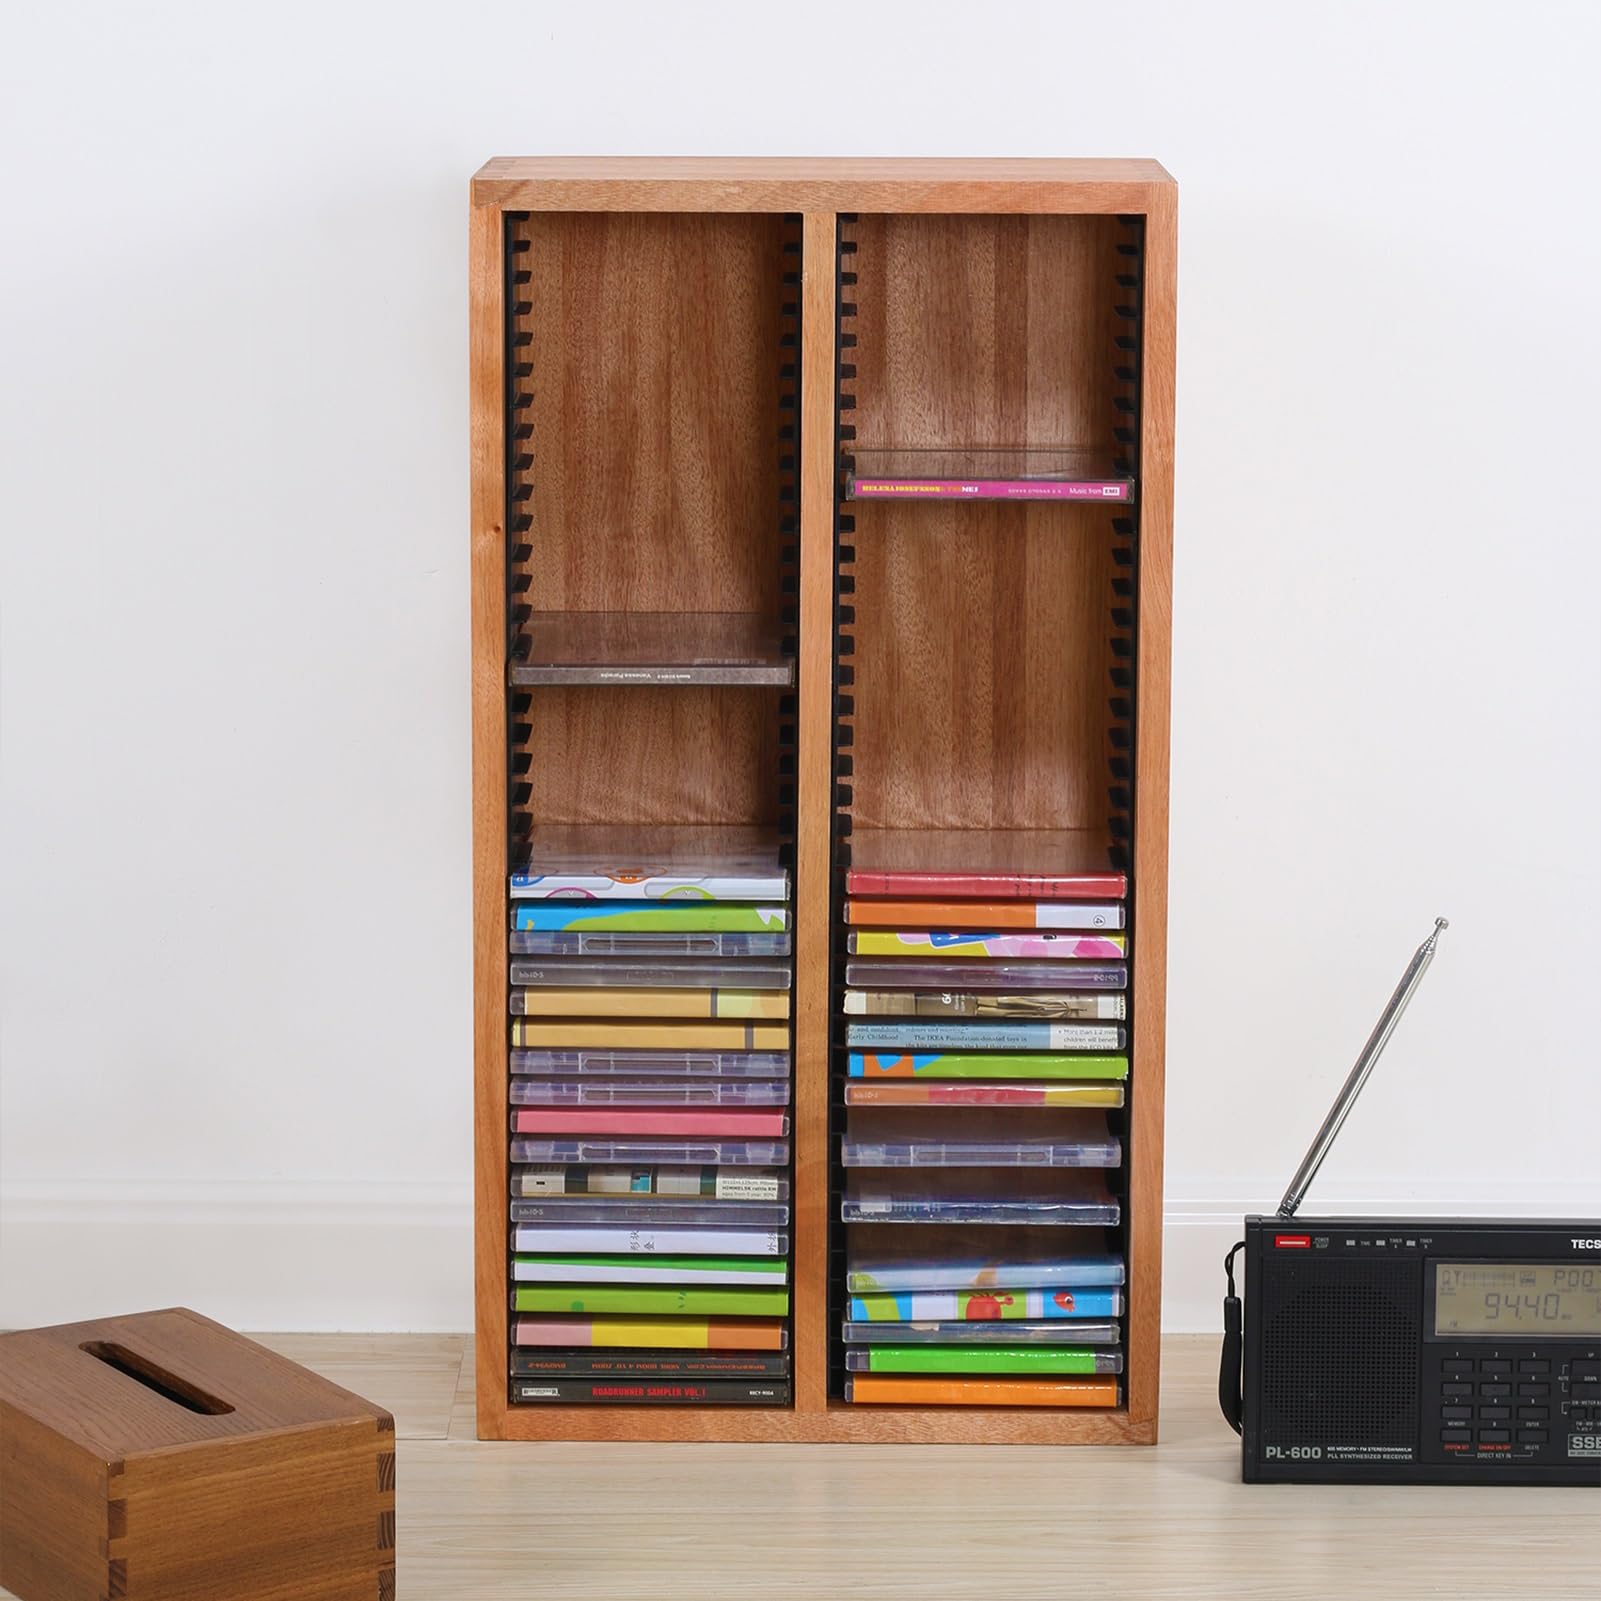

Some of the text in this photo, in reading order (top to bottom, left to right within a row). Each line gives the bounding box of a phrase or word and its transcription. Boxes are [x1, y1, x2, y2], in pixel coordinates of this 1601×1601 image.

[1069, 487, 1087, 495] Music
[1088, 487, 1103, 495] from
[1571, 1239, 1601, 1249] TECS
[591, 1387, 644, 1397] ROADRUNNER
[647, 1387, 681, 1397] SAMPLER
[1265, 1446, 1322, 1459] PL-600
